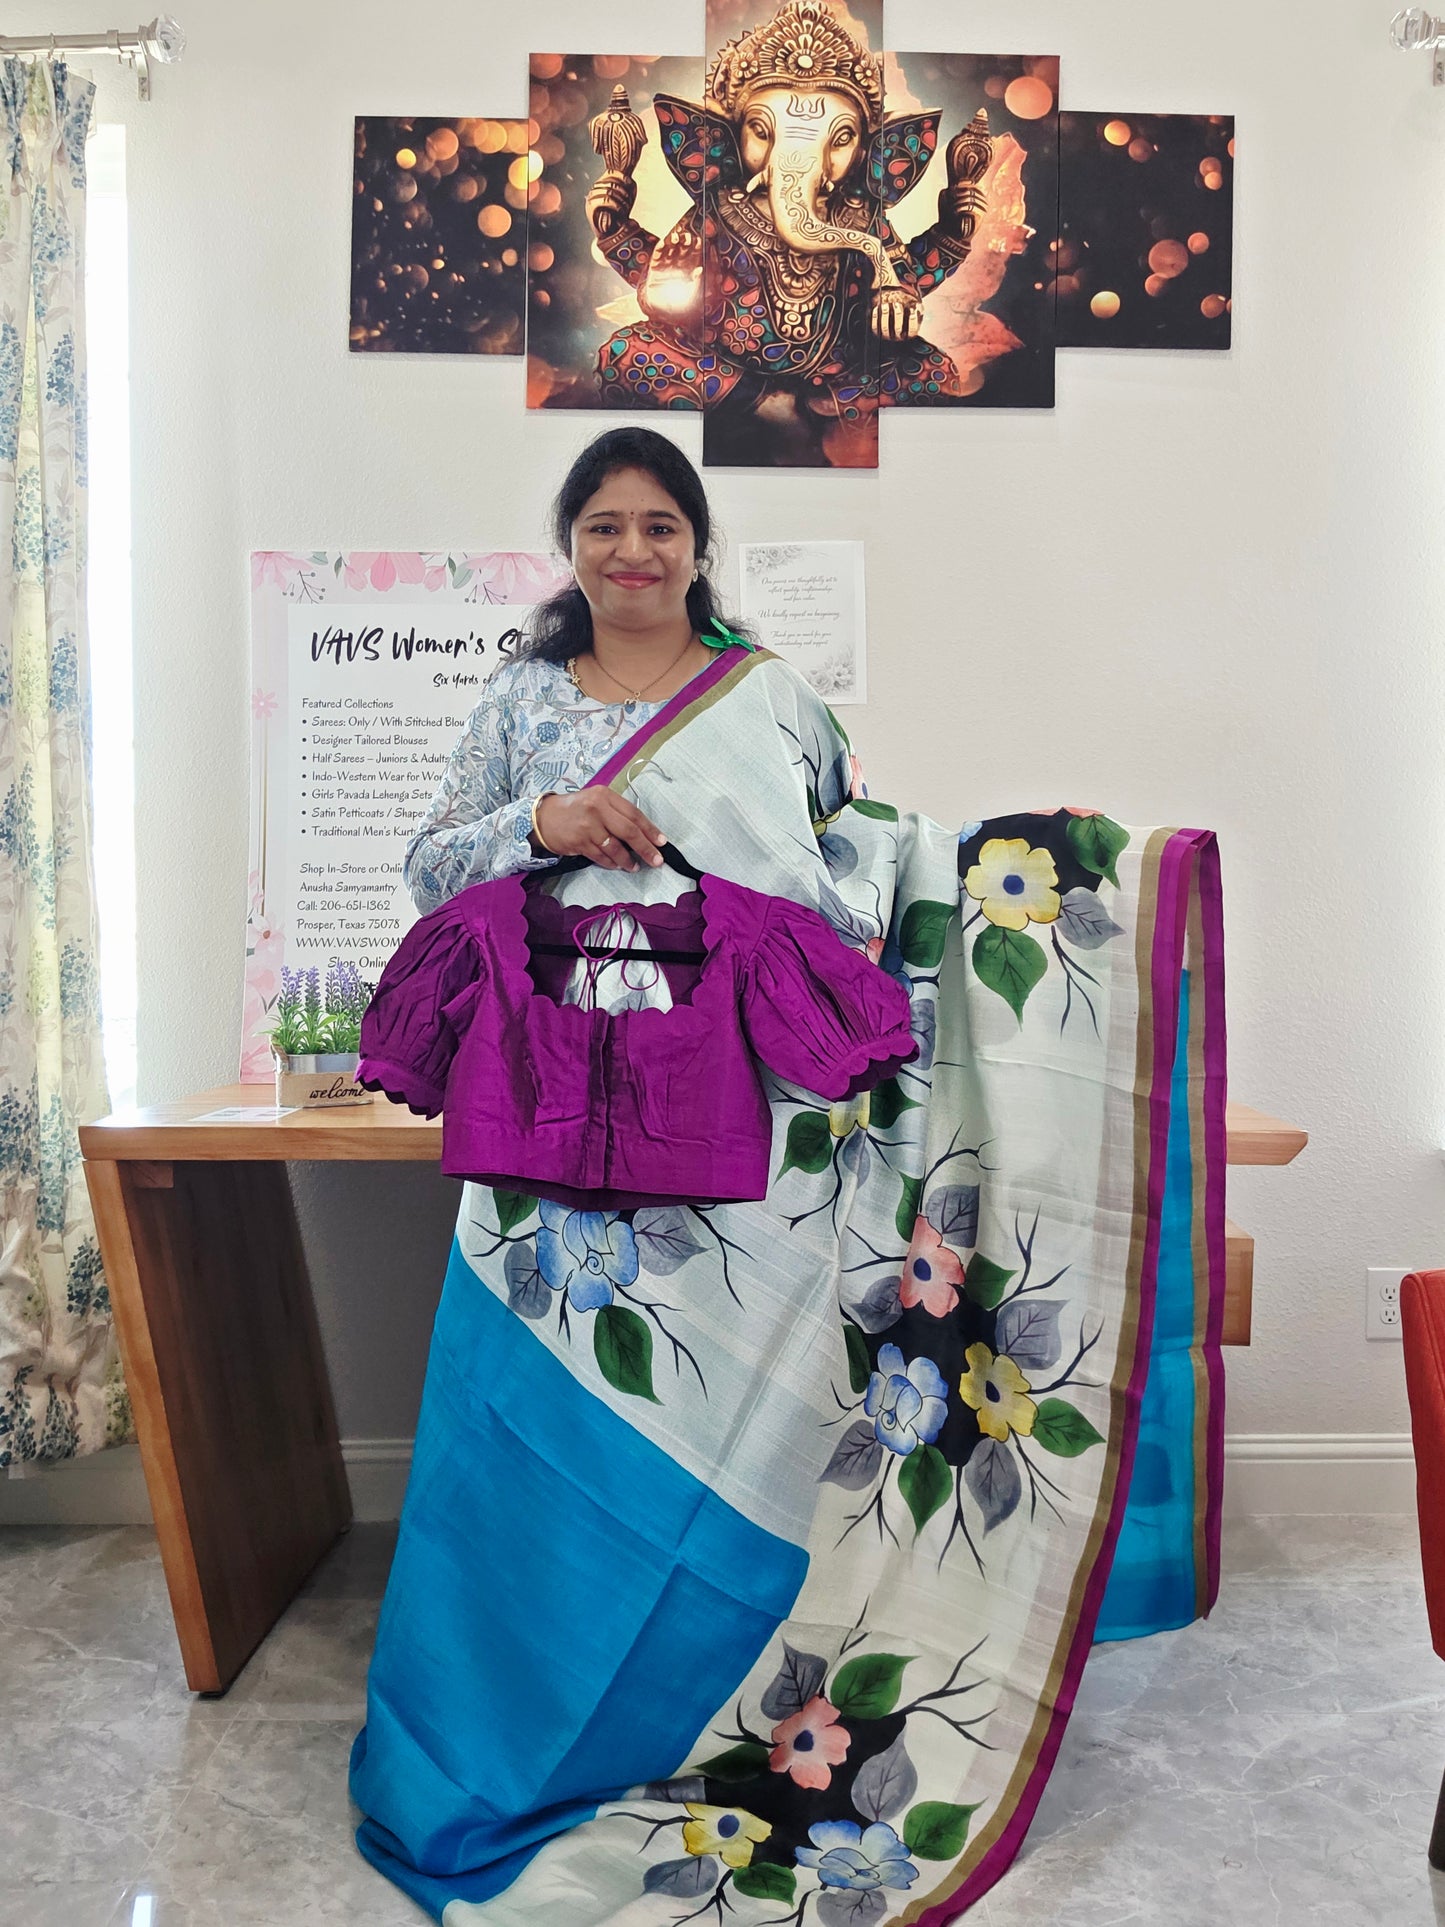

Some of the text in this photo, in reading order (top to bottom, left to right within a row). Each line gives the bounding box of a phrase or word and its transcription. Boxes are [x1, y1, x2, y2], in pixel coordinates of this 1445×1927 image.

[311, 625, 384, 665] VAVS
[392, 627, 485, 661] Women's
[433, 673, 448, 688] Six
[452, 673, 478, 689] Yards
[302, 698, 394, 709] Featured Collections
[311, 716, 465, 730] Sarees: Only / With Stitched Blou
[312, 735, 428, 748] Designer Tailored Blouses
[312, 753, 333, 763] Half
[333, 753, 365, 763] Sarees
[376, 752, 408, 764] Juniors
[410, 752, 419, 763] &
[312, 771, 376, 781] Indo-Western
[379, 771, 404, 781] Wear
[406, 771, 419, 781] for
[311, 789, 433, 802] Girls Pavada Lehenga Sets
[311, 807, 336, 818] Satin
[338, 807, 384, 818] Petticoats
[386, 807, 392, 818] /
[312, 826, 416, 836] Traditional Men's Kurt
[300, 863, 324, 877] Shop
[327, 863, 366, 874] In-Store
[368, 866, 379, 874] or
[300, 882, 398, 896] Anusha Samyamantry
[296, 900, 391, 911] Call: 206-651-1362
[296, 918, 401, 933] Prosper, Texas 75078
[296, 937, 404, 948] WWW.VAVSWOM
[309, 1076, 365, 1100] welcome
